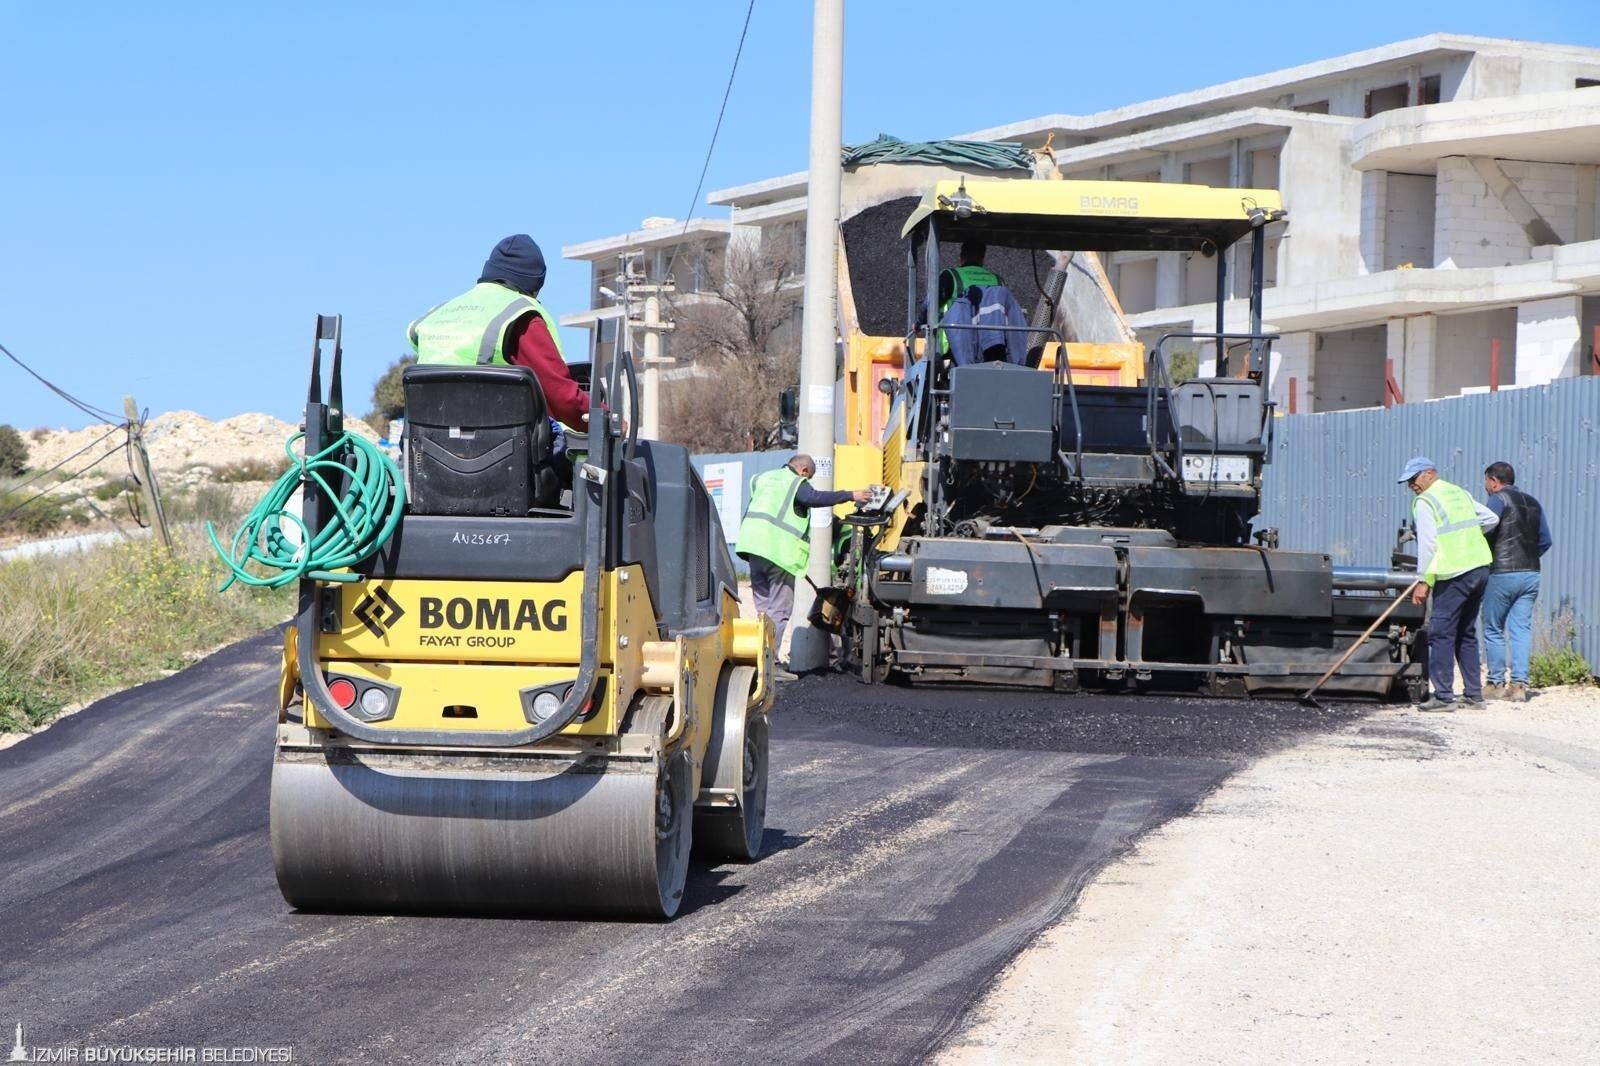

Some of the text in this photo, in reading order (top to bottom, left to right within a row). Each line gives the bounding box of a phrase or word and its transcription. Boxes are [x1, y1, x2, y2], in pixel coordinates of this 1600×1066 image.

[1080, 195, 1138, 210] BOMAG
[420, 597, 567, 631] BOMAG
[420, 635, 516, 648] FAYAT GROUP
